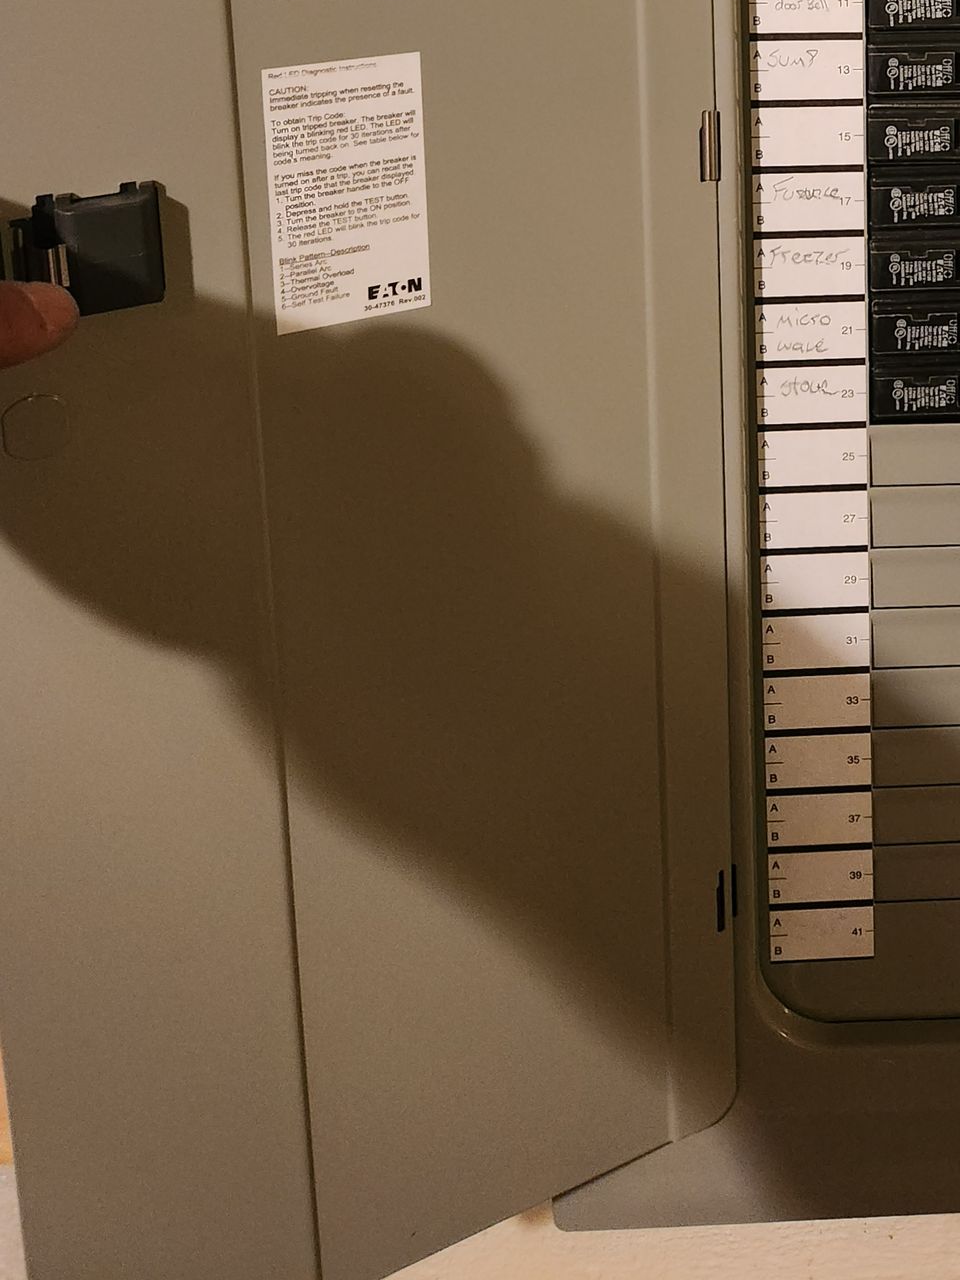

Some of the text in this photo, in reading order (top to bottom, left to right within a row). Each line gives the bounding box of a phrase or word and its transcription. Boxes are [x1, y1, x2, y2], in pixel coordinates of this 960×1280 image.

[838, 65, 850, 75] 13
[839, 132, 851, 142] 15
[838, 195, 852, 206] 17
[839, 260, 853, 272] 19
[368, 277, 422, 300] EATON
[841, 326, 852, 335] 21
[841, 389, 854, 398] 23
[842, 451, 856, 462] 25
[843, 514, 856, 523] 27
[844, 575, 857, 584] 29
[846, 636, 858, 645] 31
[846, 695, 859, 705] 33
[847, 755, 860, 765] 35
[848, 814, 861, 823] 37
[849, 870, 863, 880] 39
[851, 927, 863, 936] 41
